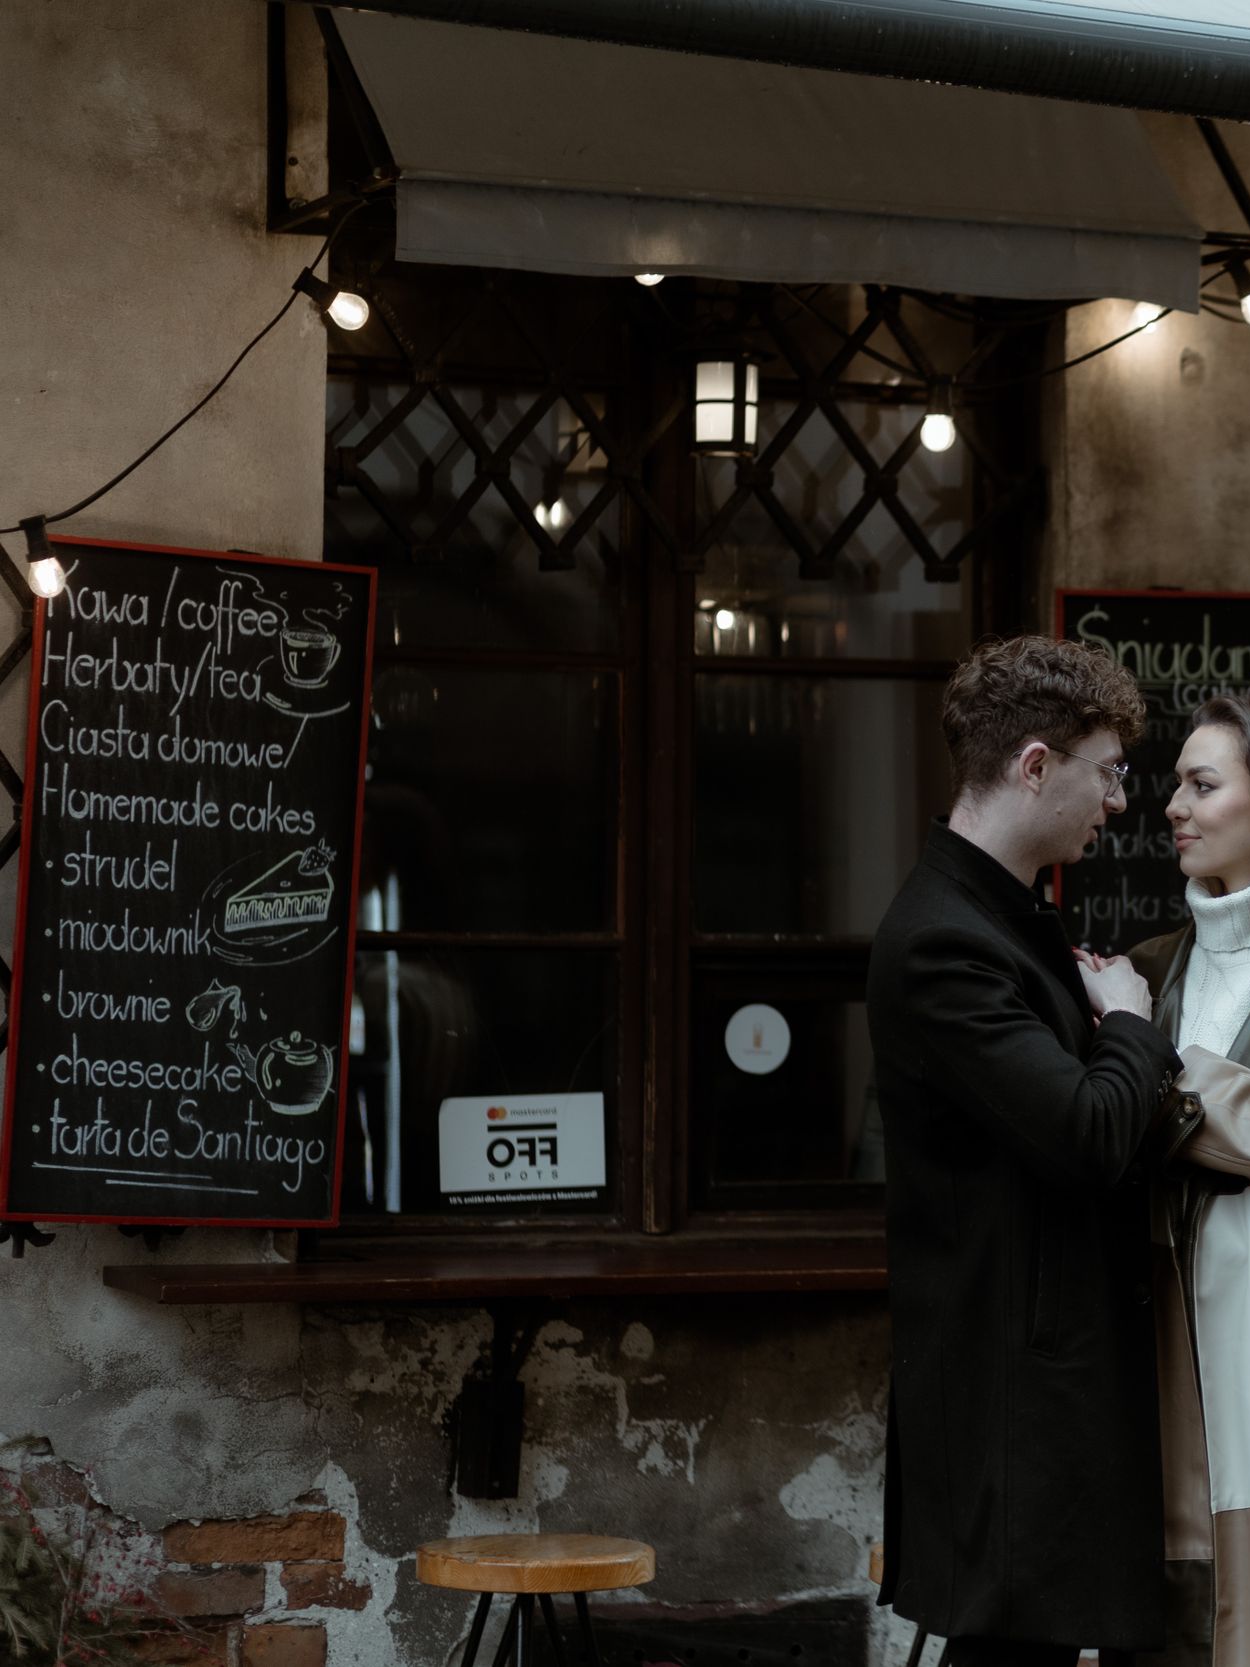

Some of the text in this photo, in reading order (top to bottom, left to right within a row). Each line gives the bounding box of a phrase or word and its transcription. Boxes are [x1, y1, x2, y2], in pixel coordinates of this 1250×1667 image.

[178, 581, 279, 655] coffee
[41, 700, 150, 759] Ciasta
[42, 763, 316, 834] Homemade cakes
[61, 829, 178, 891] strudel
[59, 906, 212, 956] miodownik
[1081, 875, 1160, 940] jajka
[58, 969, 171, 1023] brownie
[51, 1032, 243, 1093] cheesecake
[510, 1106, 558, 1117] mastercard
[50, 1097, 326, 1192] tarta de Santiago
